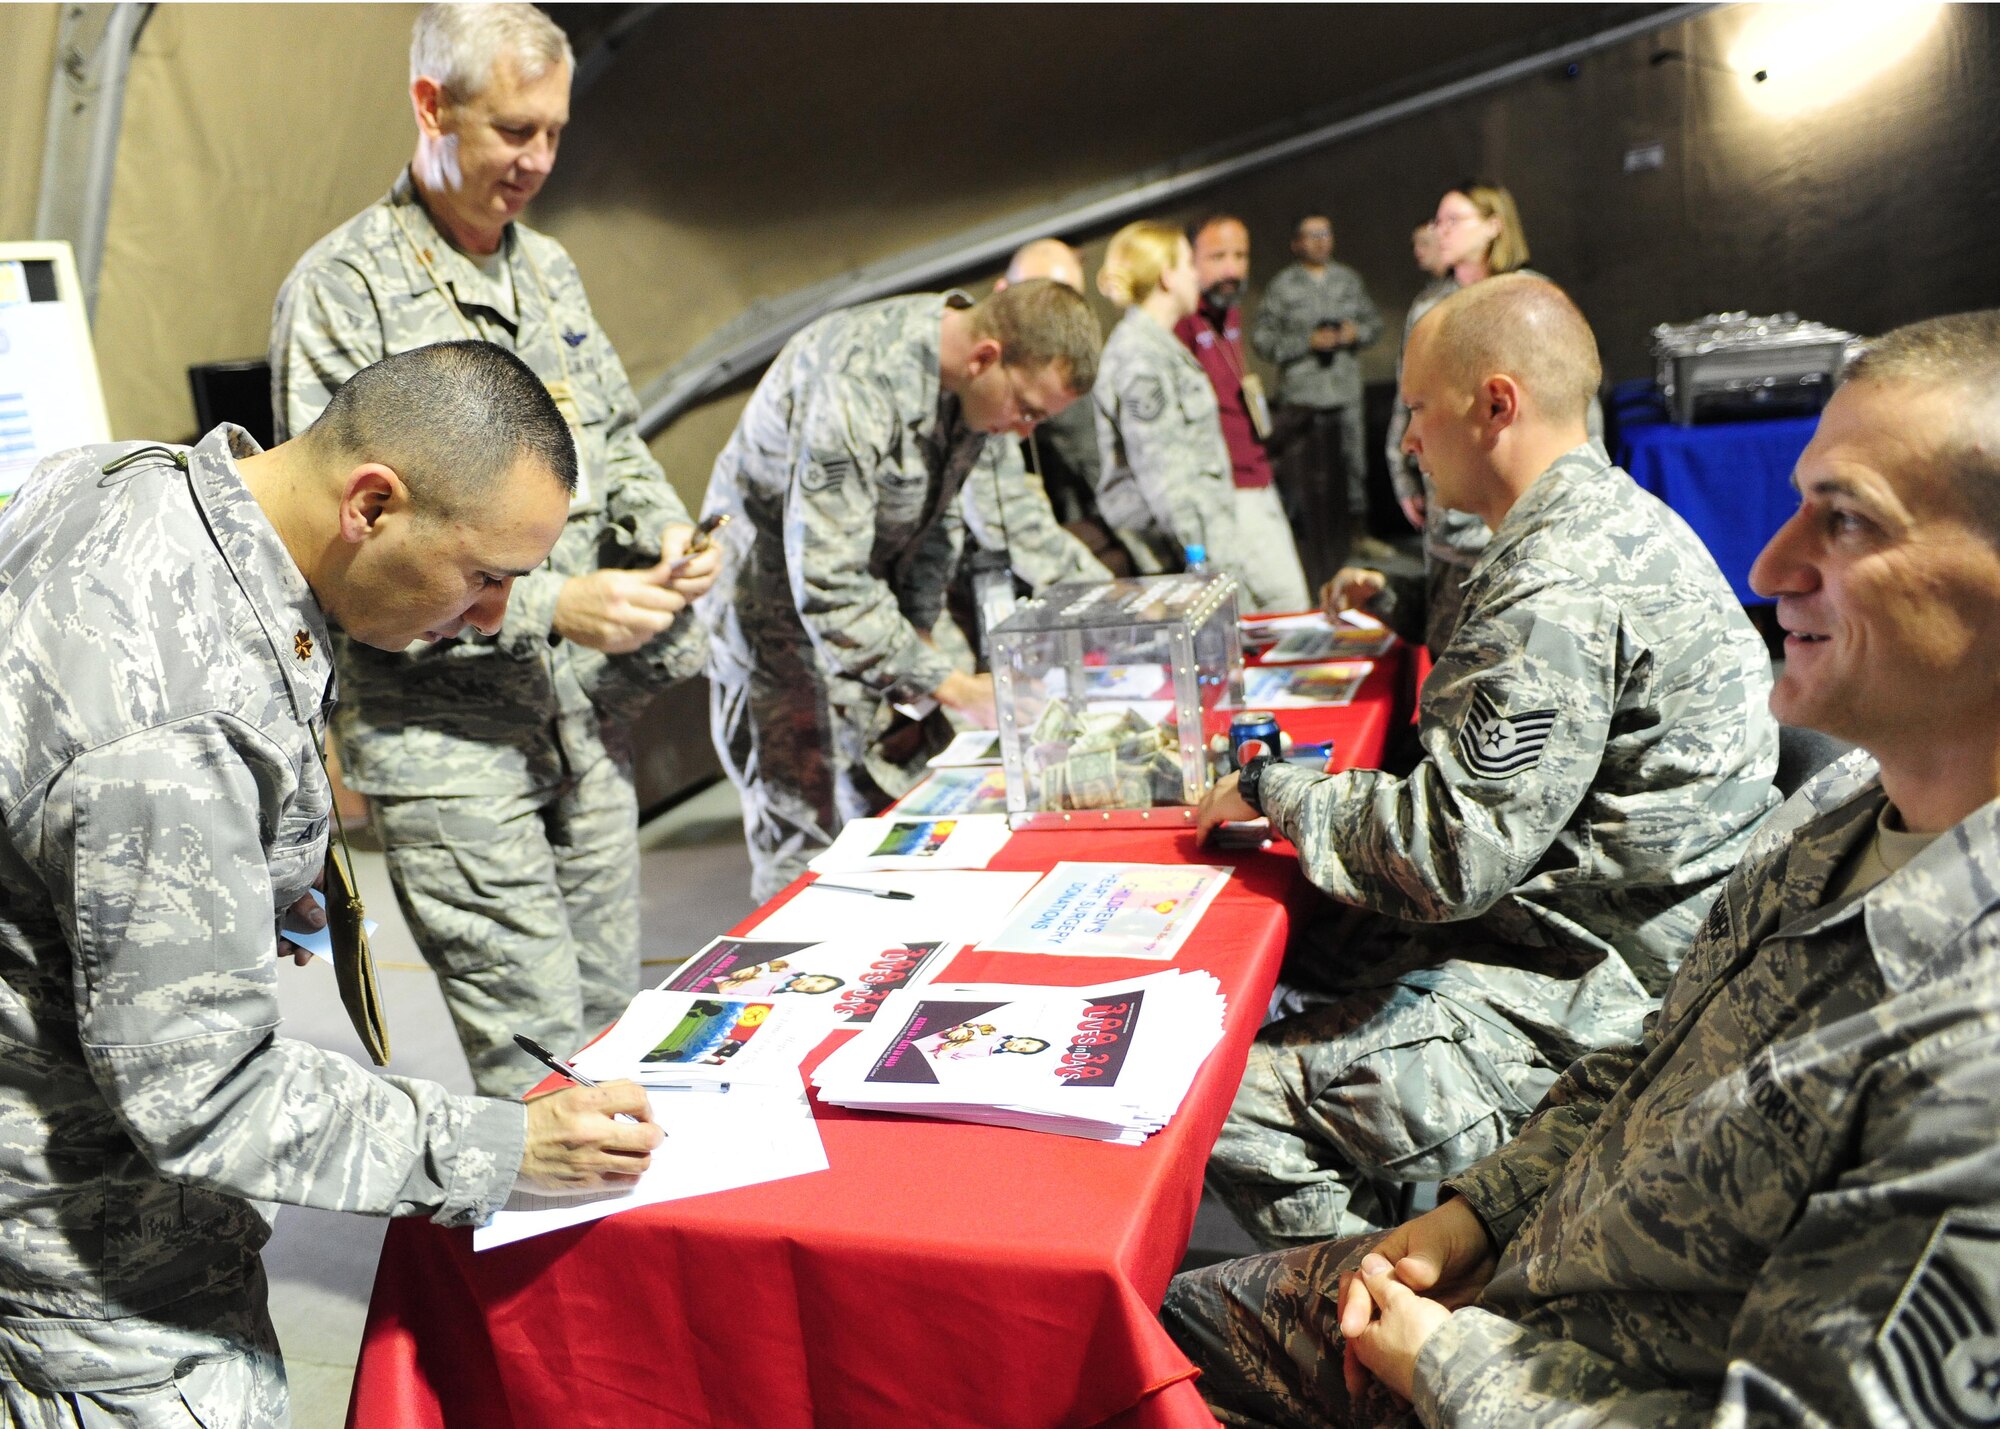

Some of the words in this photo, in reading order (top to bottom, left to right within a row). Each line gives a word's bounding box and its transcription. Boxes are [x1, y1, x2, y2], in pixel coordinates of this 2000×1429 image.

[1030, 881, 1087, 929] DONATIONS
[1083, 882, 1139, 933] CHILDREN'S
[1046, 900, 1096, 944] SURGERY
[864, 953, 908, 983] LIVES
[834, 988, 874, 1015] DAYS
[1077, 1011, 1107, 1044] LIVES
[1074, 1045, 1092, 1053] in
[1061, 1052, 1091, 1080] DAYS
